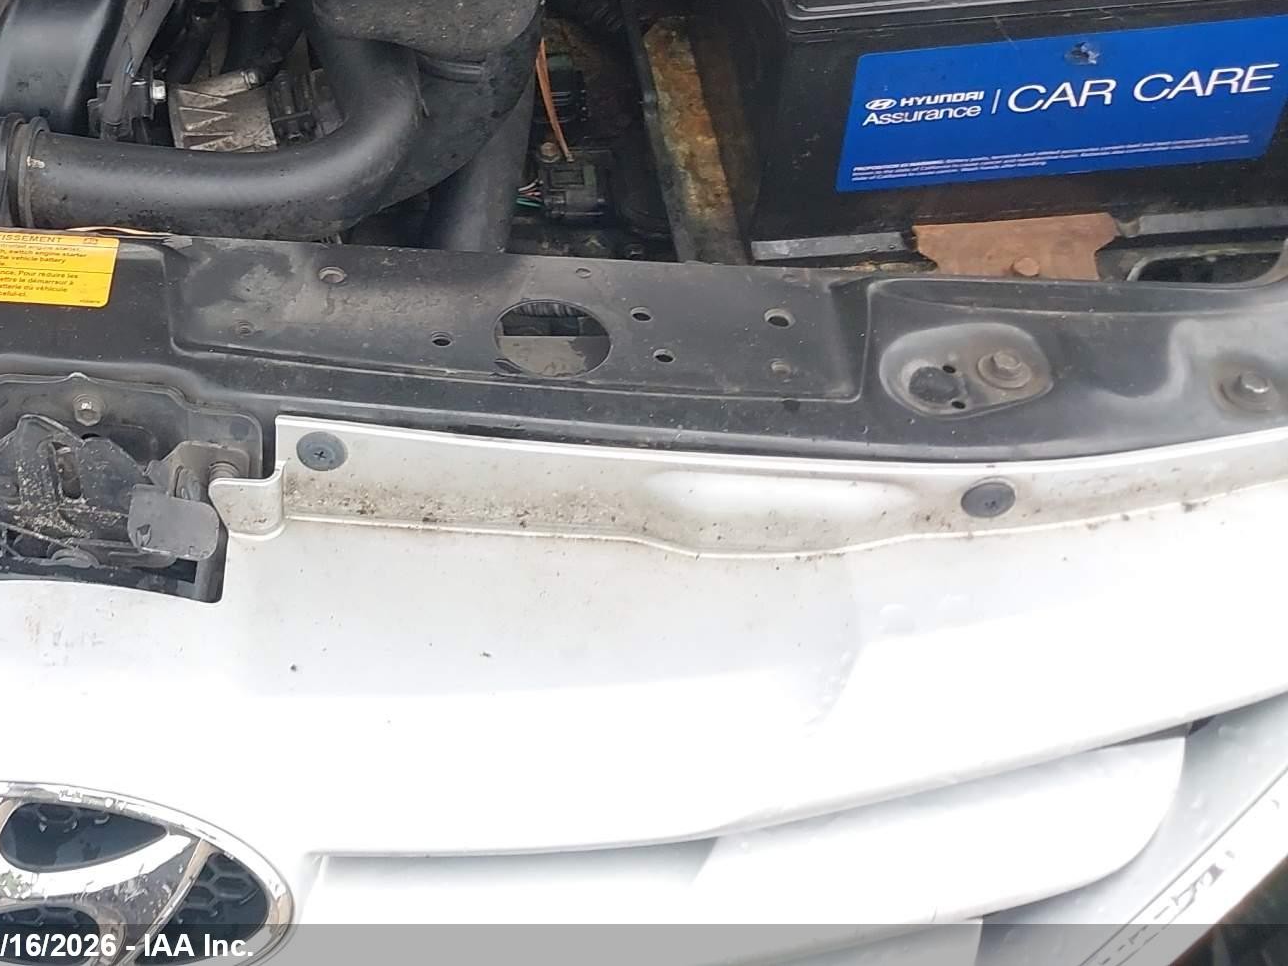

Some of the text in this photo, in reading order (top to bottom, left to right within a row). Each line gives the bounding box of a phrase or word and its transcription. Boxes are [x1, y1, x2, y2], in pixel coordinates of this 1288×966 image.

[900, 90, 985, 107] HYUNDAI
[1007, 63, 1280, 113] CAR CARE
[862, 105, 982, 126] Assurance
